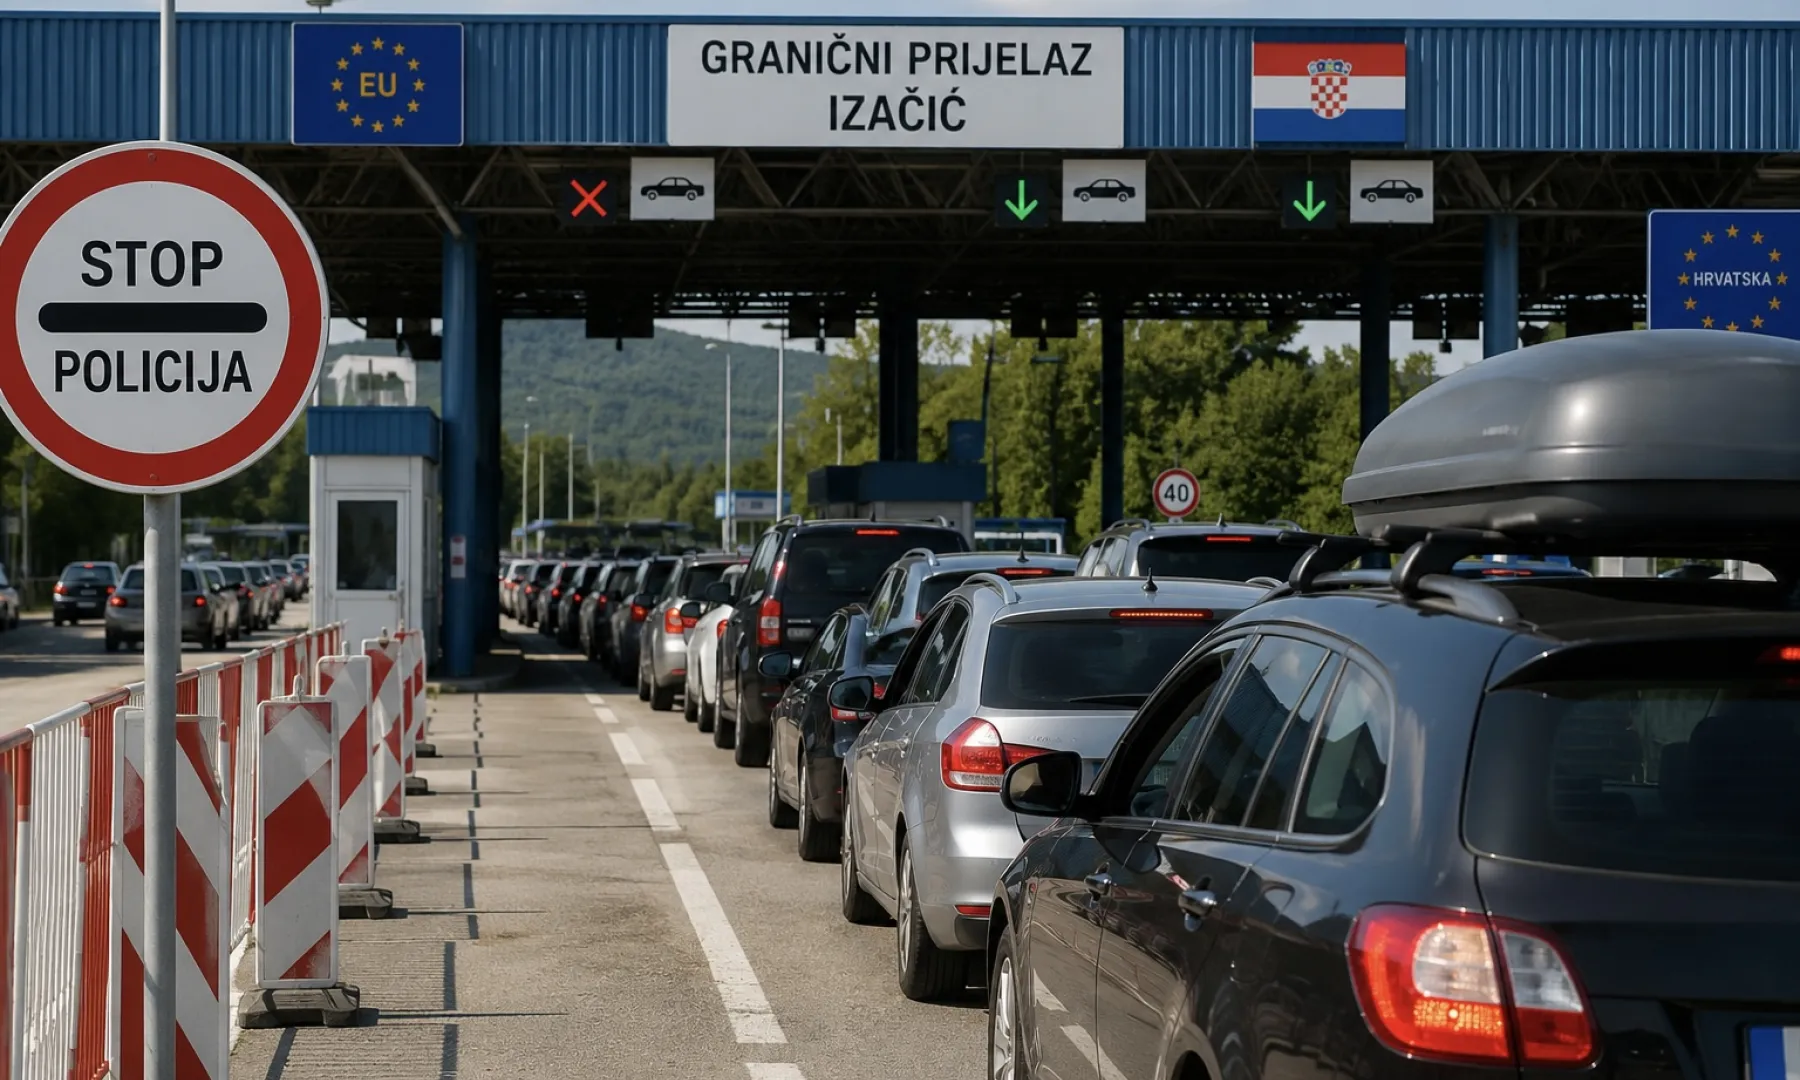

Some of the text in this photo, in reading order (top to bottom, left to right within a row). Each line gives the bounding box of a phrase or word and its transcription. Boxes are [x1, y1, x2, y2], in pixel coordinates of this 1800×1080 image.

[701, 33, 1092, 76] GRANIČNI PRIJELAZ
[360, 72, 397, 97] EU
[829, 87, 966, 132] IZAČIĆ
[81, 240, 223, 287] STOP
[1694, 271, 1772, 287] HRVATSKA
[54, 350, 252, 393] POLICIJA
[1164, 483, 1189, 502] 40
